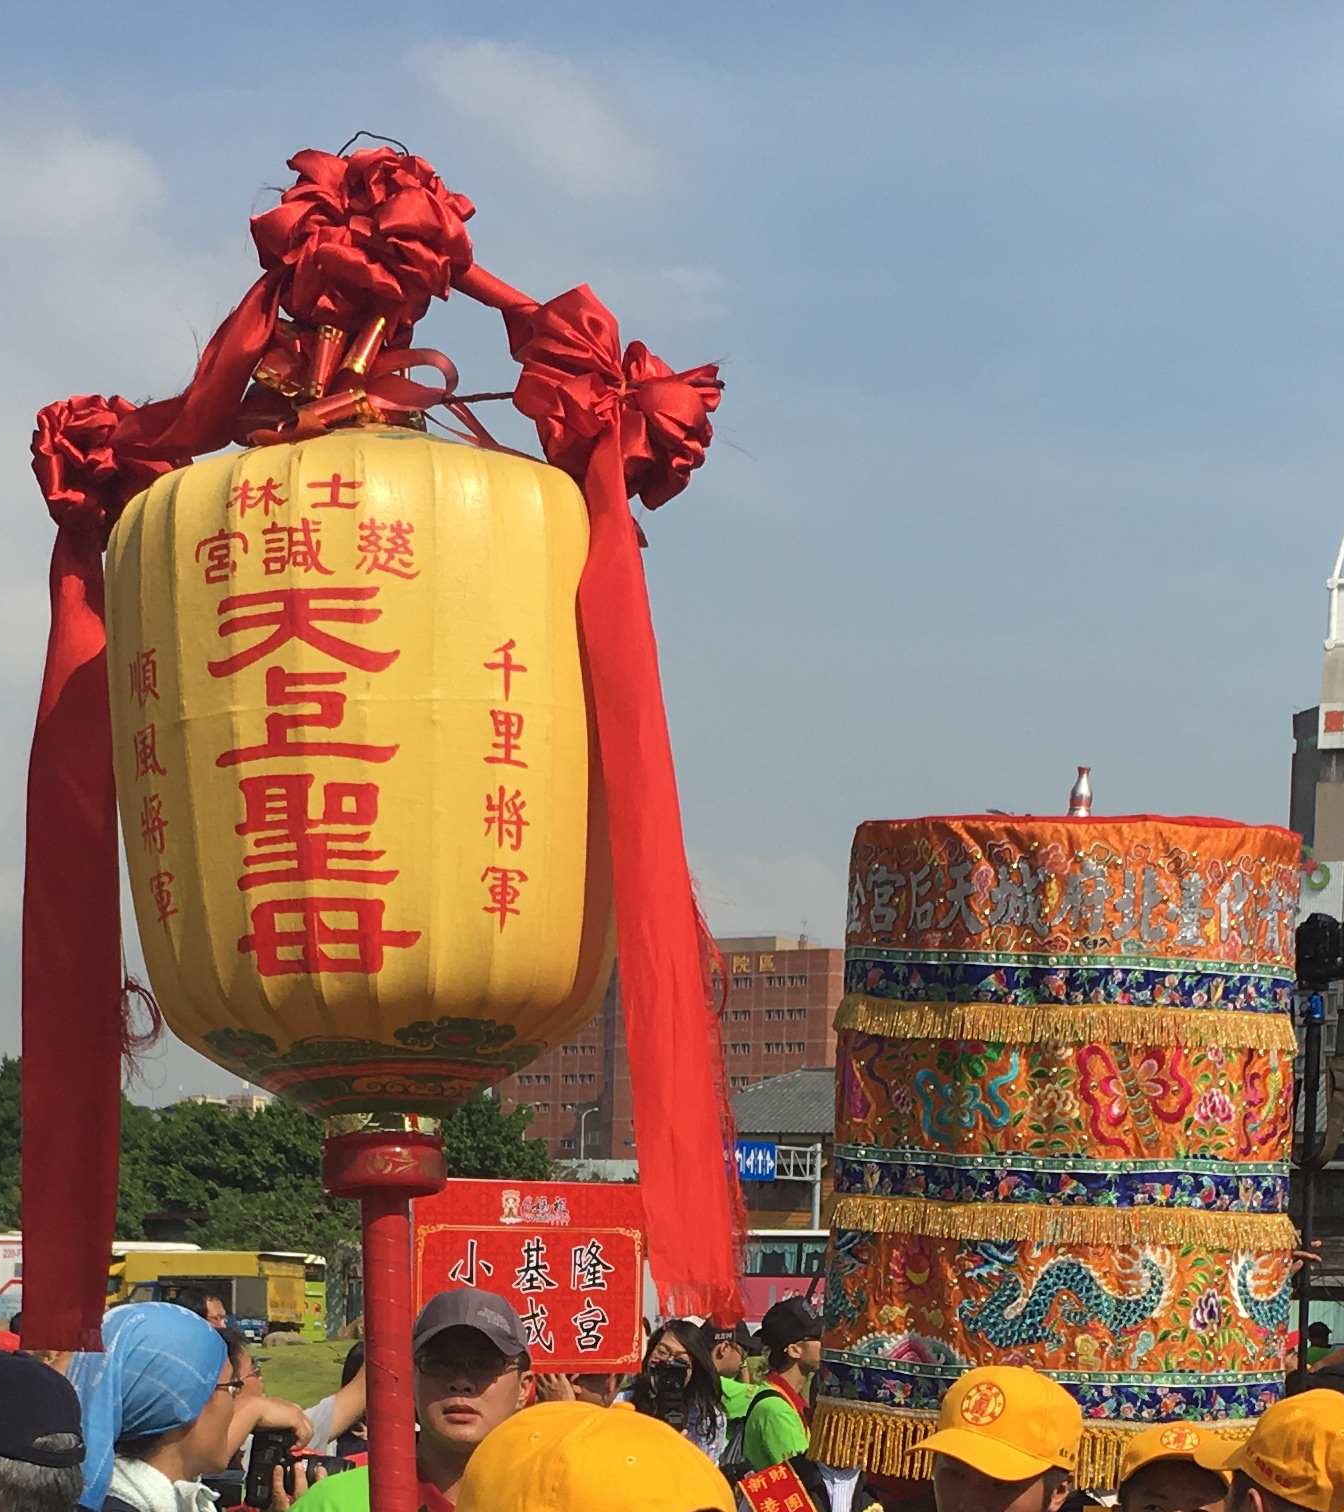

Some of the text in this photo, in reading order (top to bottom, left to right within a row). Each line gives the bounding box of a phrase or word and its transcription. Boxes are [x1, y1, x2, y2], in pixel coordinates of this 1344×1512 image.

[227, 474, 362, 518] 士林
[128, 648, 177, 936] 順風將軍
[207, 586, 422, 978] 天上聖母
[480, 638, 531, 934] 千里將軍
[448, 1238, 615, 1294] 小基隆
